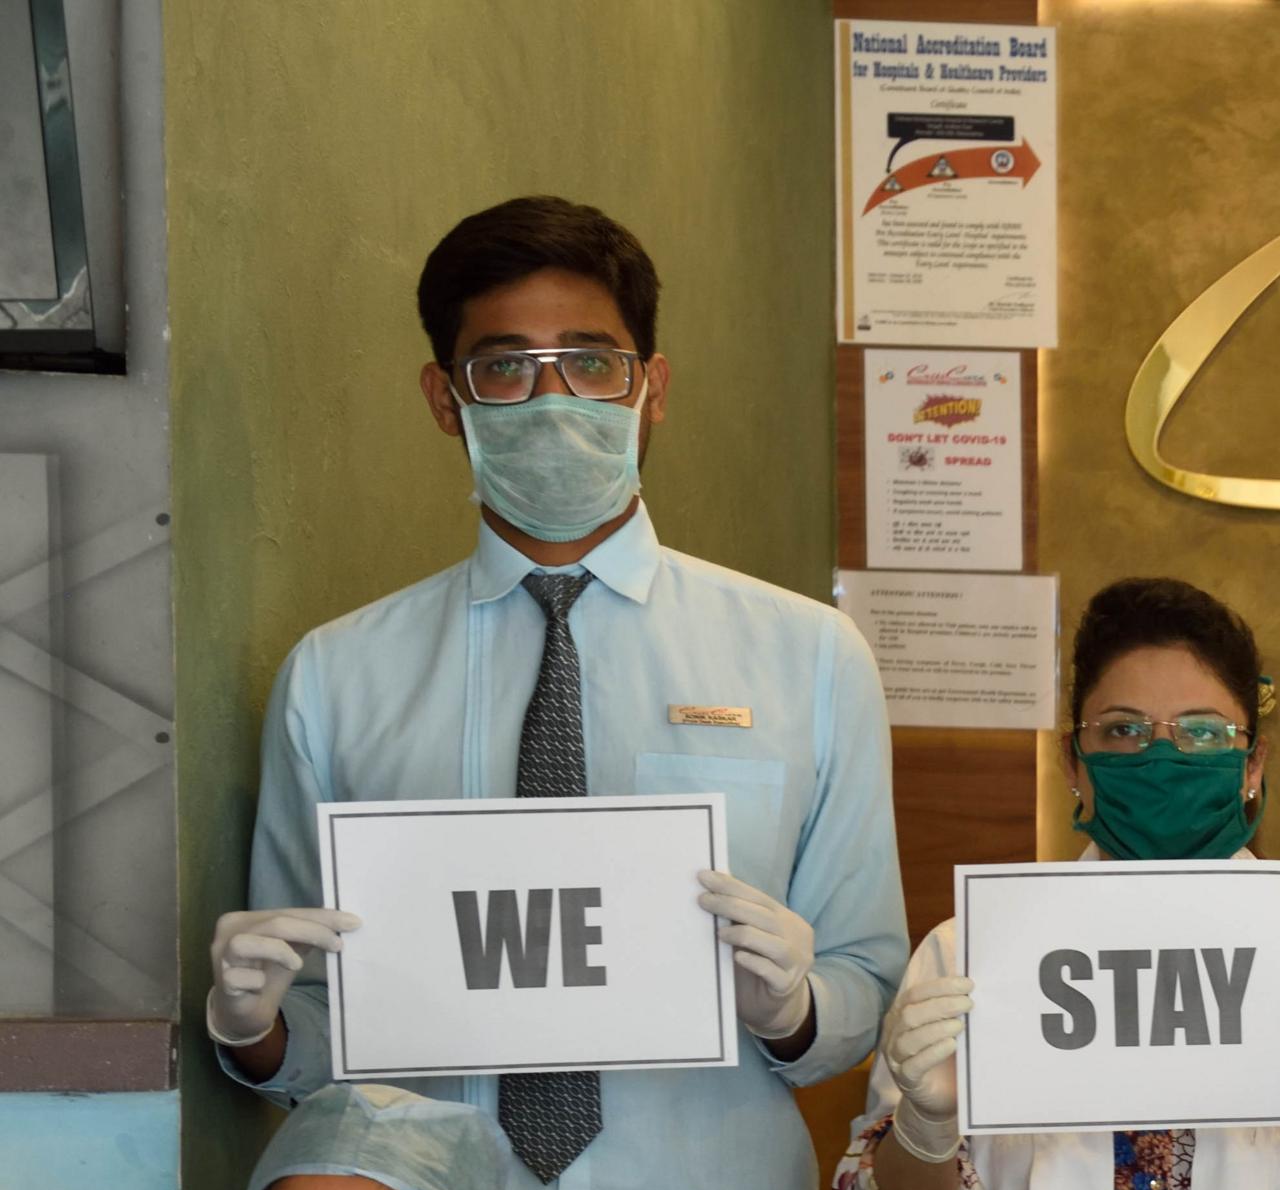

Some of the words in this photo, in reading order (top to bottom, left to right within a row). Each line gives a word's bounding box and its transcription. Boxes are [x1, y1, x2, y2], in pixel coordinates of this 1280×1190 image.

[853, 33, 907, 54] National
[916, 34, 1000, 56] Accreditation
[1009, 37, 1047, 58] Board
[853, 61, 868, 77] for
[873, 61, 919, 81] Hospitals
[925, 63, 935, 79] &
[940, 63, 994, 81] Healthcare
[1000, 65, 1047, 82] Providers
[887, 433, 923, 443] DON'T
[926, 434, 948, 444] LET
[952, 434, 1007, 445] COVID-19
[944, 456, 992, 466] SPREAD
[452, 888, 607, 990] WE
[1040, 948, 1256, 1049] STAY
